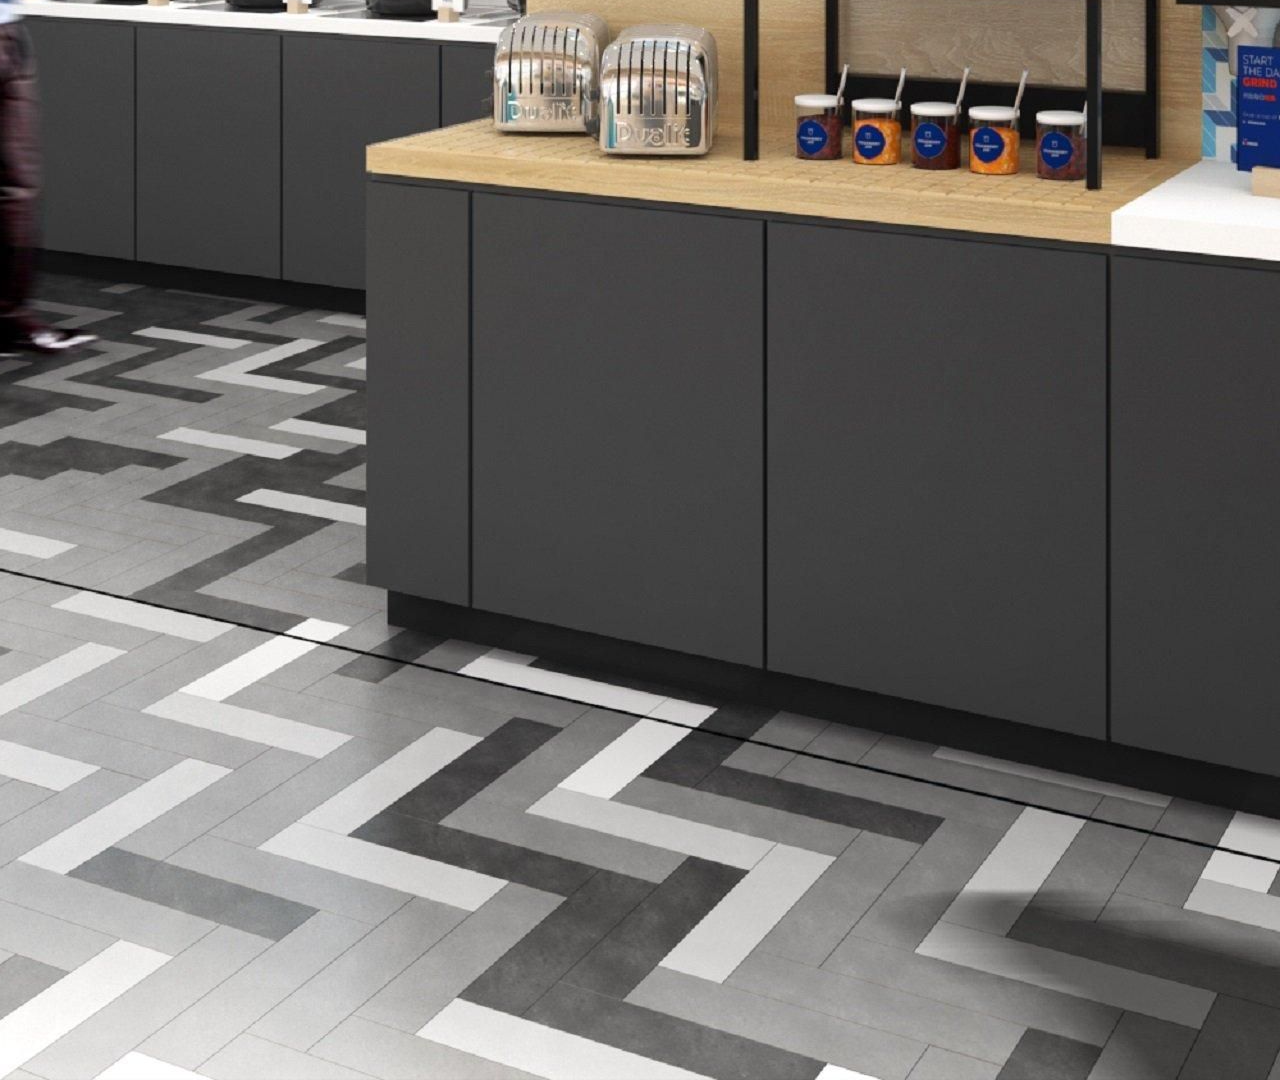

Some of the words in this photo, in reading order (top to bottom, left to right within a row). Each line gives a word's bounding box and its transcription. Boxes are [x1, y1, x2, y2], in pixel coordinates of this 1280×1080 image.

[1243, 55, 1273, 66] START
[1243, 65, 1262, 76] THE
[616, 121, 692, 147] Dualit
